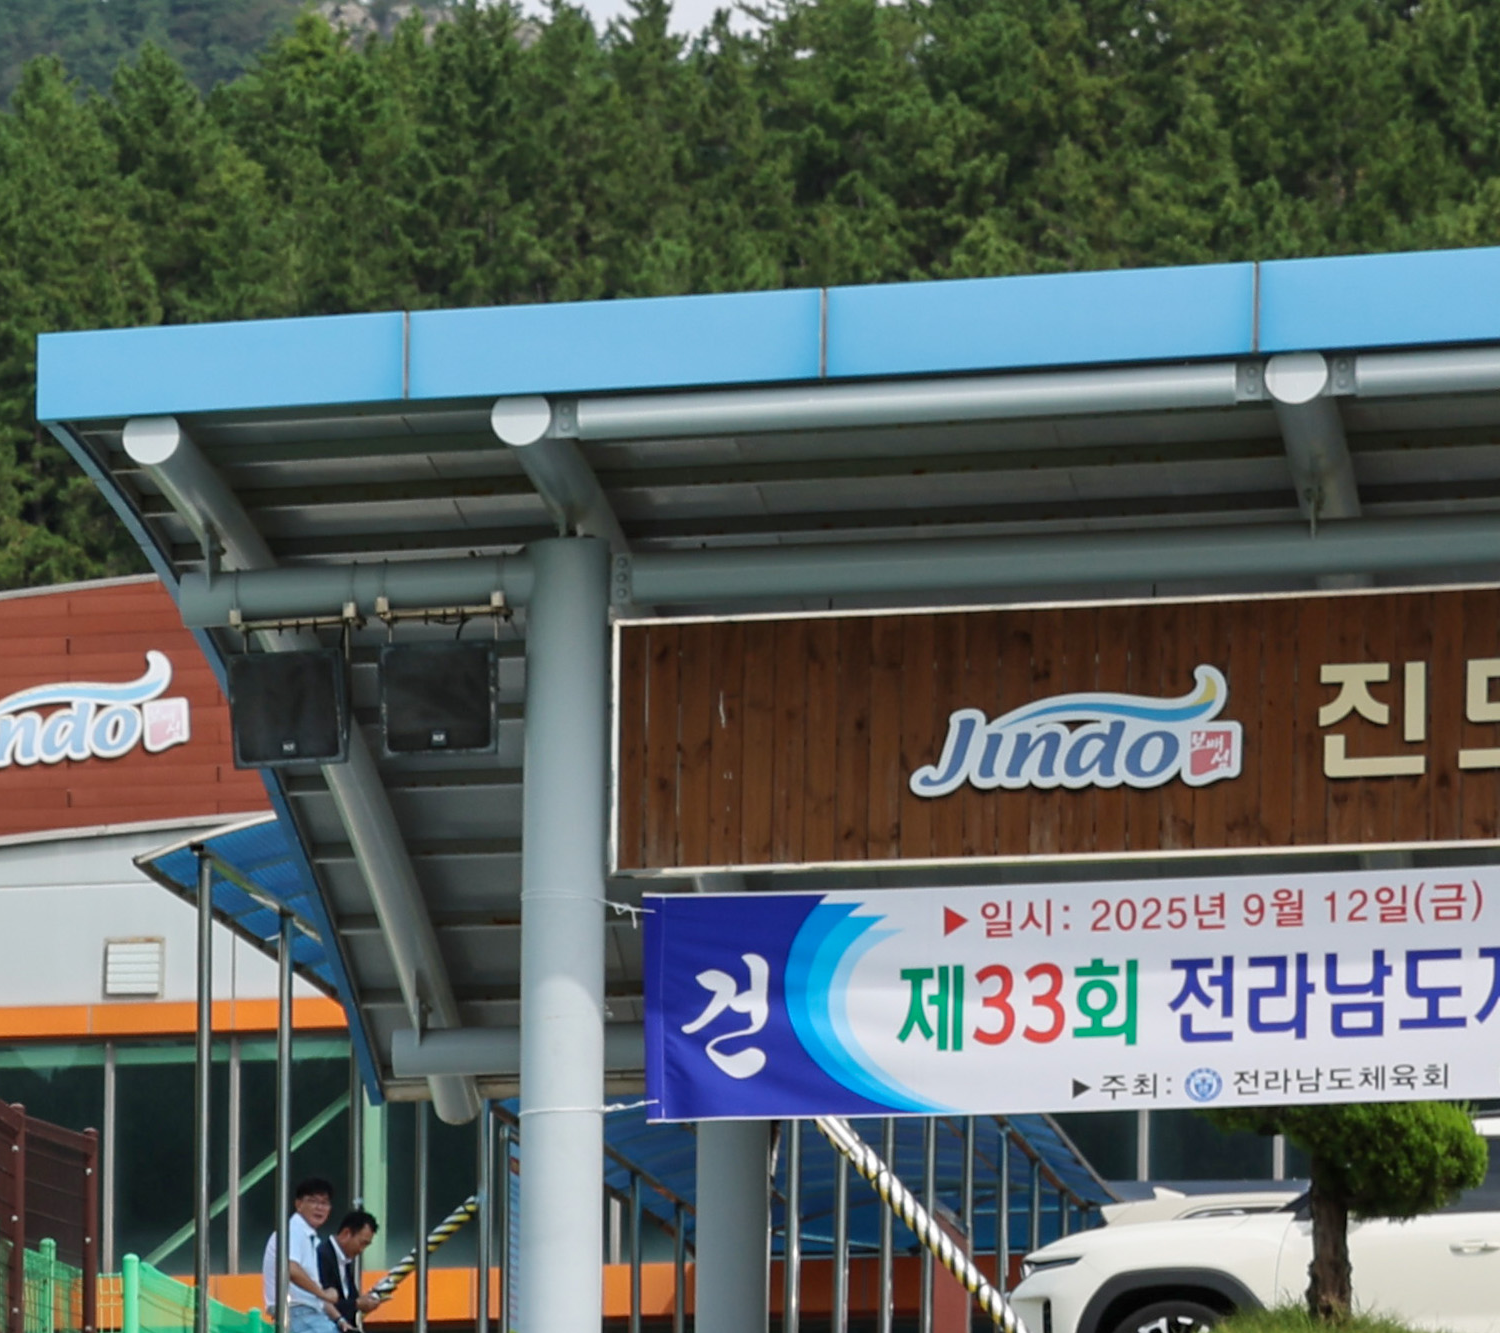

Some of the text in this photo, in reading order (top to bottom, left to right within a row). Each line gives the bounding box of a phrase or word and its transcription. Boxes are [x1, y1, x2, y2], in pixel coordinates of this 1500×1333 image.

[918, 718, 1181, 788] Jindo
[980, 879, 1484, 939] 일시: 2025년 9월 12일(금)
[896, 957, 1140, 1052] 제33회
[1099, 1062, 1449, 1100] 주최: 전라남도체육회
